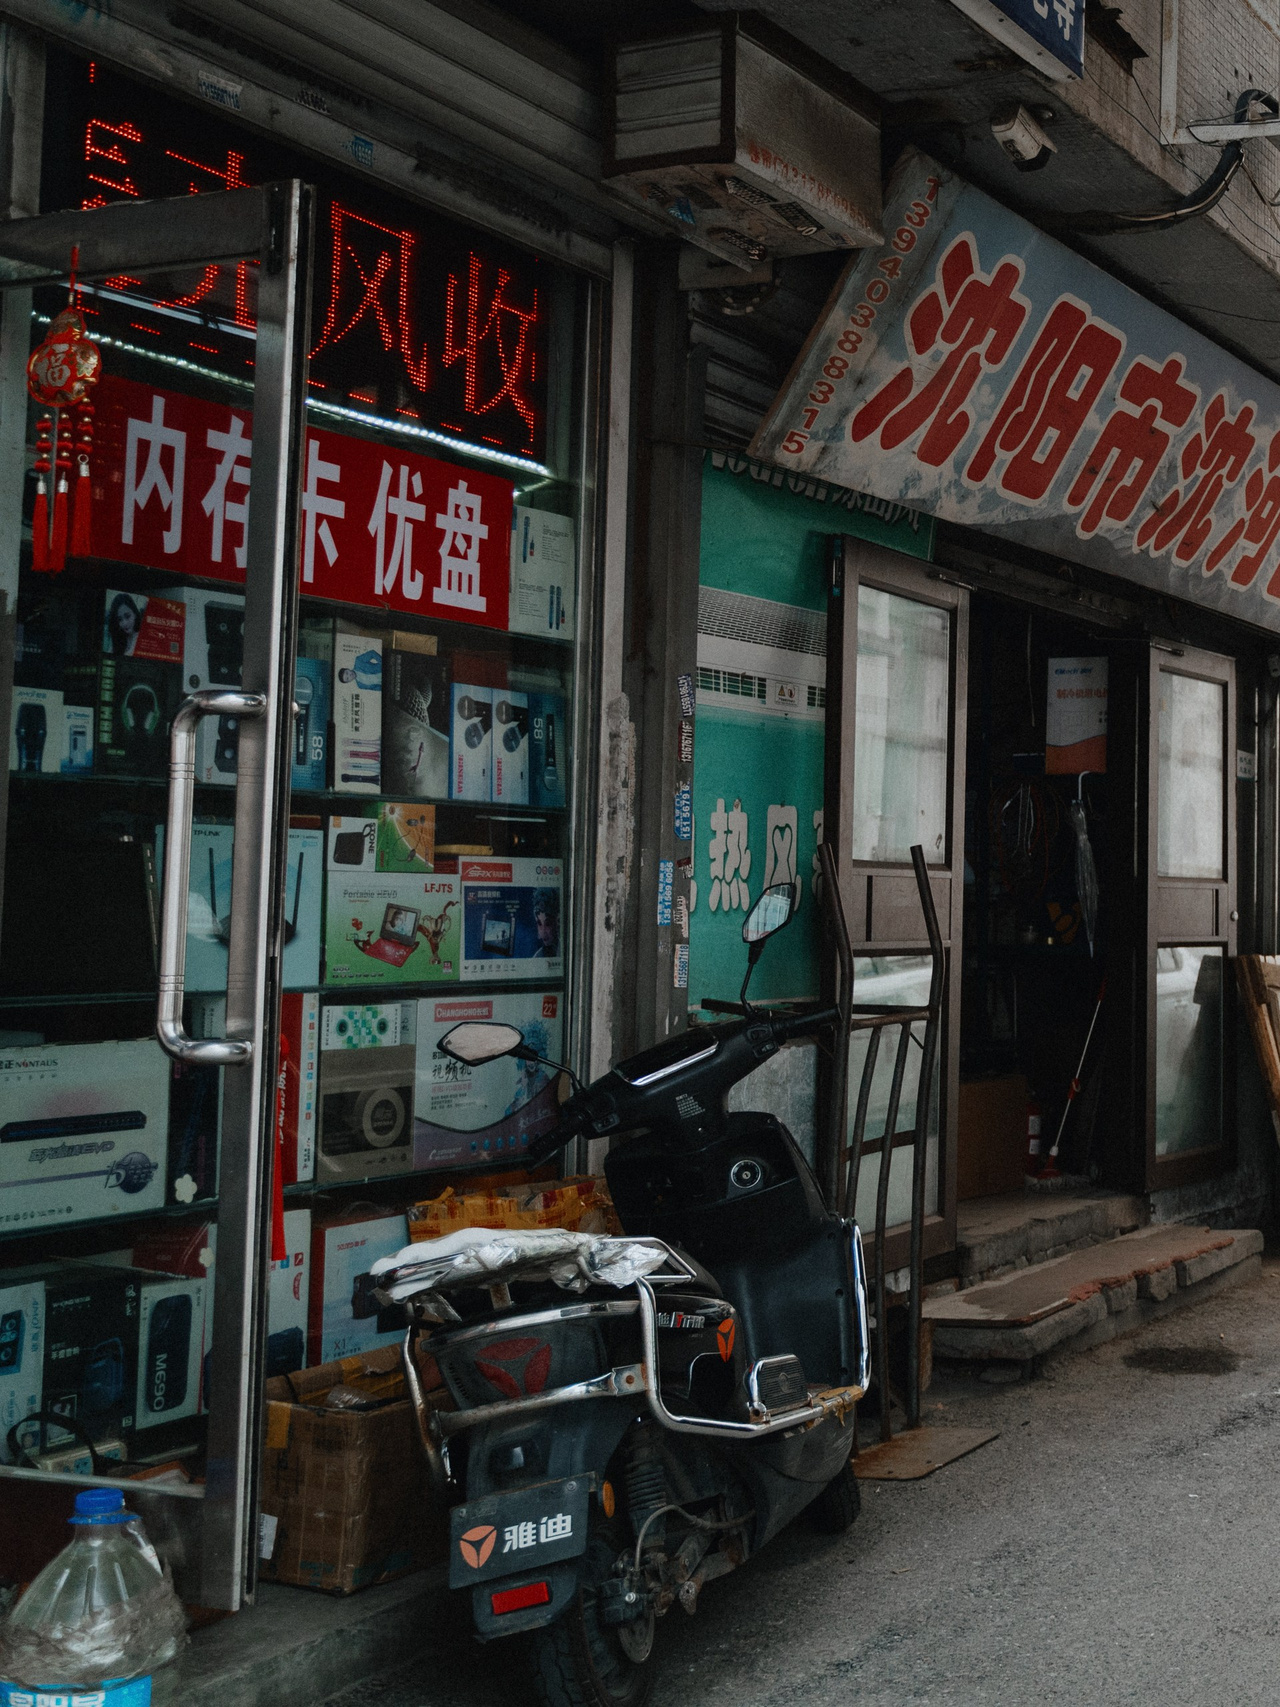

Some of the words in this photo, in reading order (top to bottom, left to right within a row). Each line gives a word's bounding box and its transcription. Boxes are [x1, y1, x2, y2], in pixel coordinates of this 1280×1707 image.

[780, 177, 943, 456] 13940388315
[36, 343, 71, 388] 福
[424, 883, 453, 893] LFJTS
[153, 1352, 169, 1412] M690
[503, 1512, 573, 1554] 雅迪
